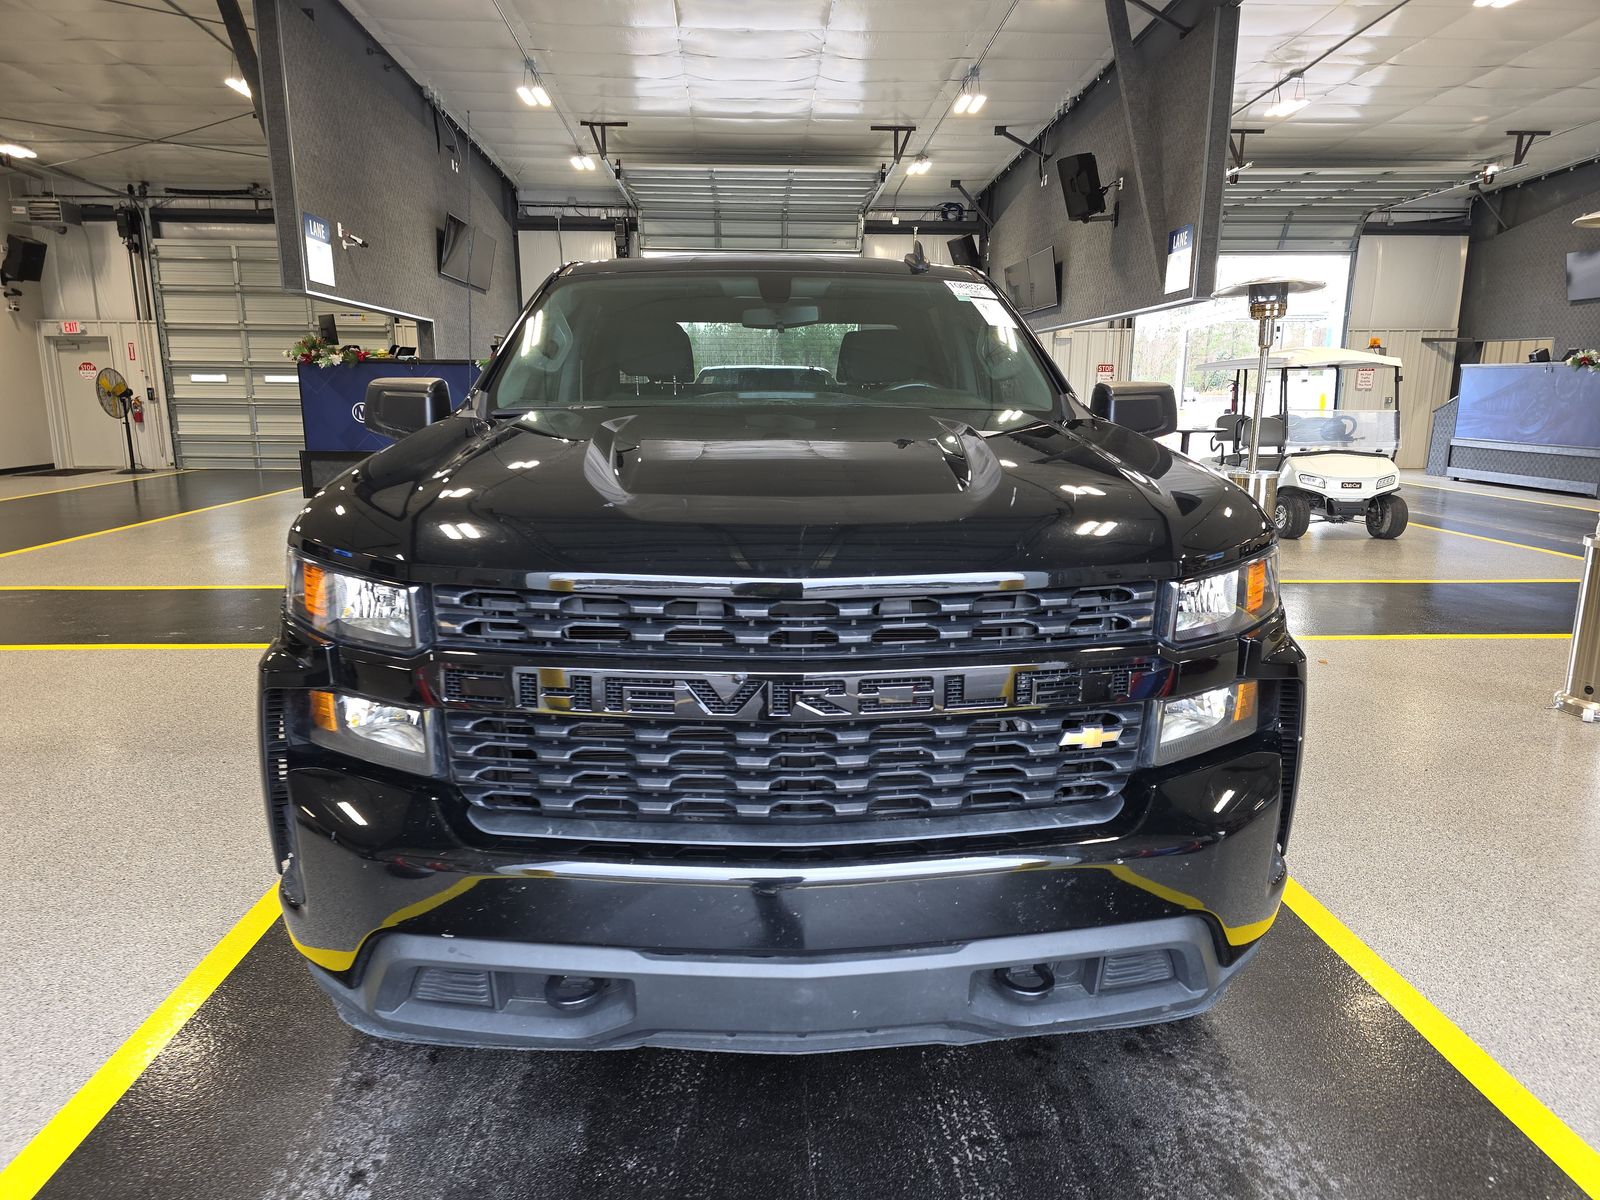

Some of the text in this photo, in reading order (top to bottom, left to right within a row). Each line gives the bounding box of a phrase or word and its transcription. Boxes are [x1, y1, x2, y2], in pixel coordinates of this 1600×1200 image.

[309, 219, 325, 240] LANE
[1172, 231, 1189, 250] LANE
[63, 321, 78, 333] EXIT
[441, 660, 1155, 717] CHEVROLET
